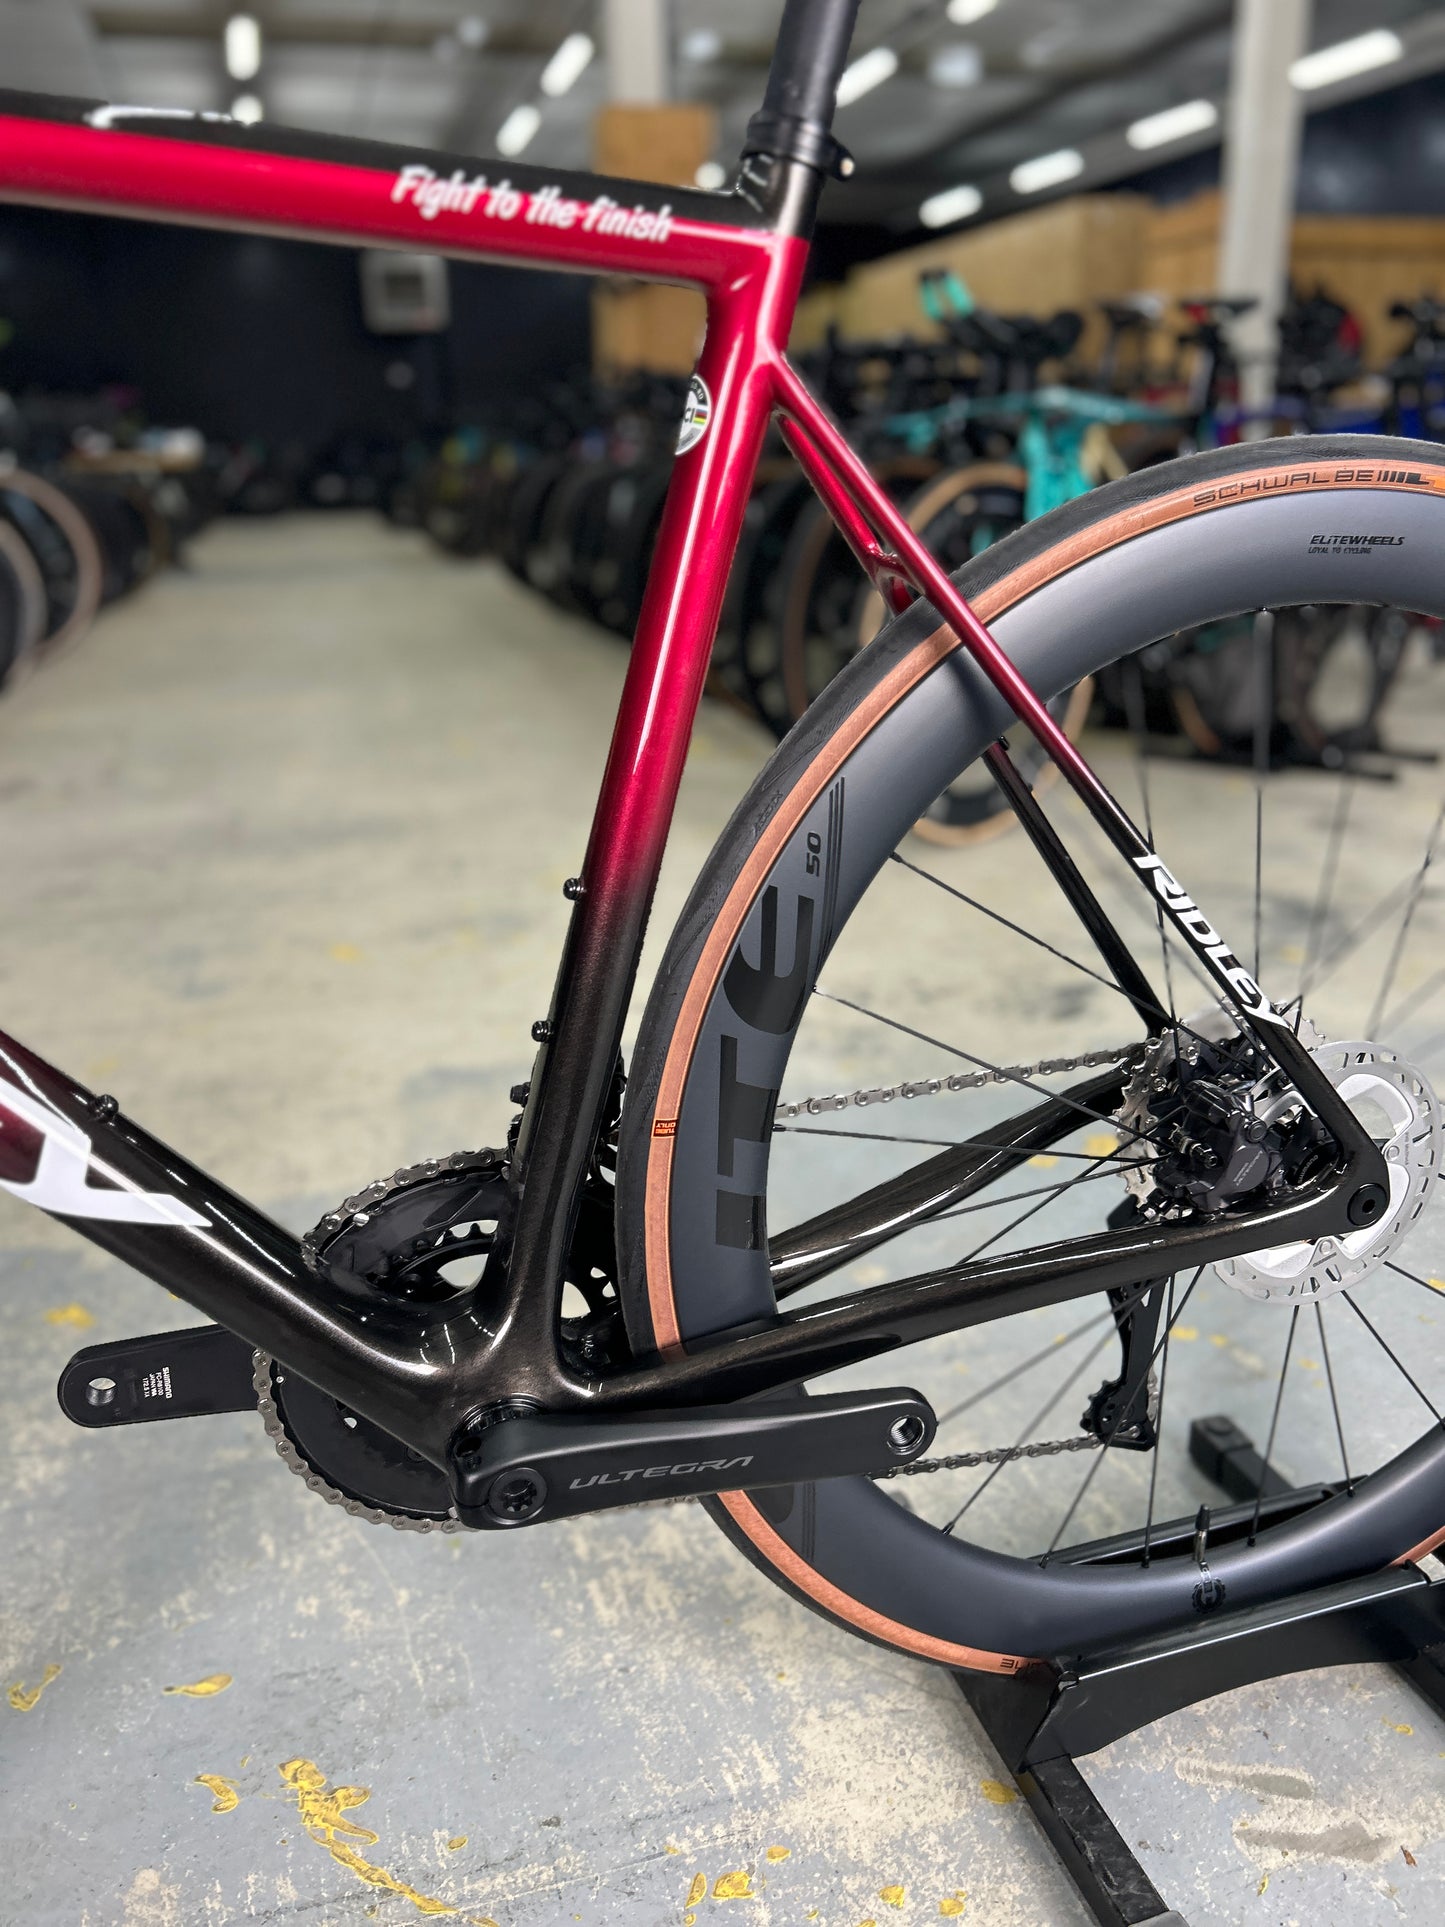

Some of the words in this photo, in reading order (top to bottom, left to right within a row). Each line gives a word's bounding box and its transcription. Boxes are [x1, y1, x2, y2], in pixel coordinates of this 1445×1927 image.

[390, 164, 487, 221] Fight
[484, 178, 523, 221] to
[525, 186, 578, 230] the
[581, 195, 673, 243] finish
[1193, 469, 1375, 507] SCHWALBE
[1308, 546, 1329, 554] LOYAL
[804, 831, 822, 877] 50
[1132, 854, 1290, 1029] RIDLEY
[162, 1366, 173, 1399] SHIMANO
[569, 1455, 754, 1490] ULTEGRA
